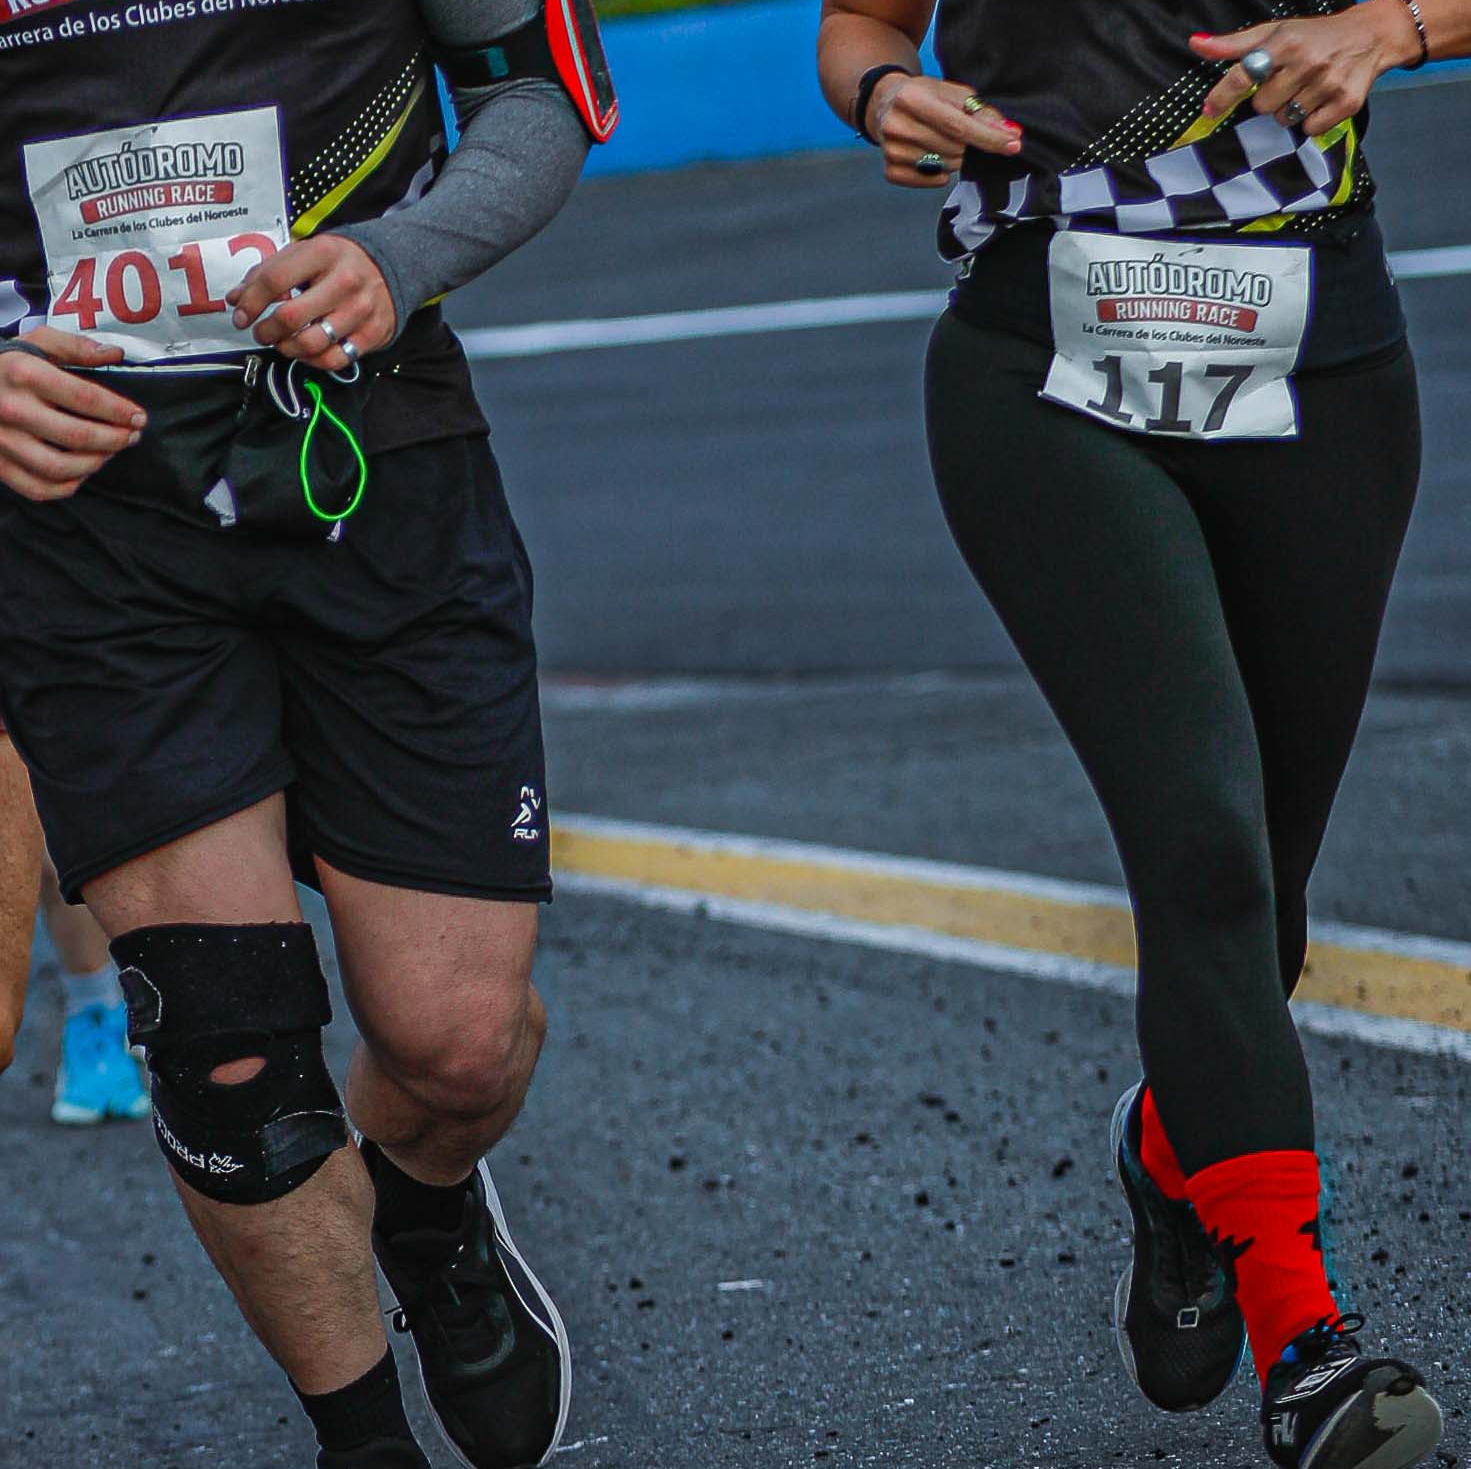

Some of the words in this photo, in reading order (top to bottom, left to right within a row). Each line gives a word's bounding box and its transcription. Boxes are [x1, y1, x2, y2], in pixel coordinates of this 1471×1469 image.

[59, 17, 85, 39] de
[90, 11, 121, 34] los
[64, 141, 244, 201] AUTÓDROMO
[97, 188, 165, 219] RUNNING
[170, 184, 215, 204] RACE
[72, 229, 83, 241] La
[84, 224, 119, 239] Carrera
[121, 222, 132, 233] de
[133, 219, 148, 232] los
[149, 214, 184, 229] Clubes
[187, 211, 203, 223] del
[205, 206, 249, 221] Noroeste
[1086, 253, 1272, 307] AUTÓDROMO
[1115, 301, 1192, 323] RUNNING
[1195, 306, 1240, 327] RACE
[1083, 323, 1094, 332] La
[1095, 326, 1133, 339] Carrera
[1135, 329, 1149, 340] de
[1152, 329, 1167, 341] los
[1169, 331, 1203, 344] Clubes
[1206, 333, 1221, 344] del
[1223, 333, 1266, 346] Noroeste
[1086, 355, 1256, 432] 117
